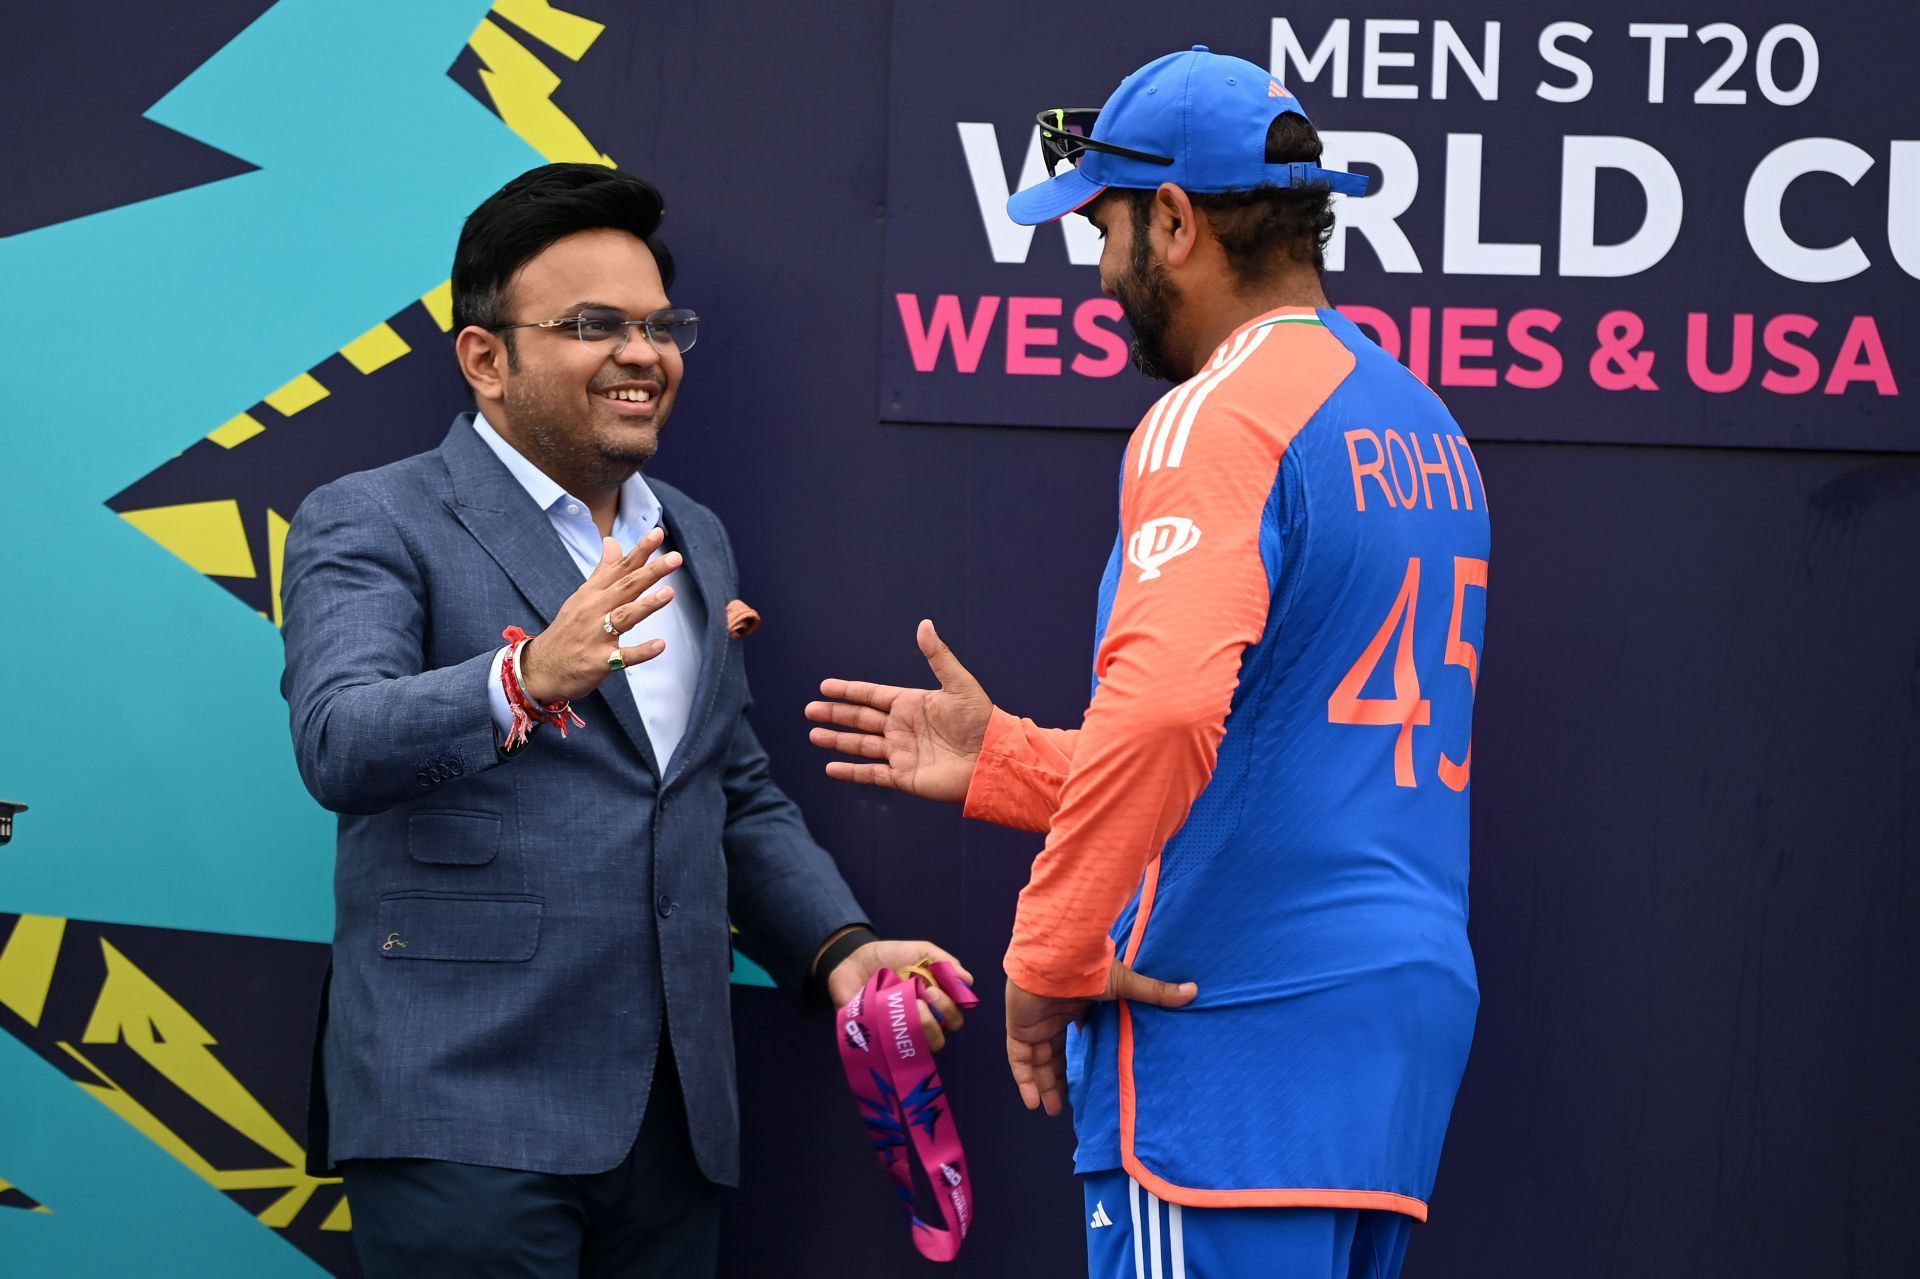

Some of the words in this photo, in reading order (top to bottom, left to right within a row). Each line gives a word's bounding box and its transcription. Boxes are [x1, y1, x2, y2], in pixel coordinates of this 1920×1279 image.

[1629, 23, 1820, 106] T20
[956, 123, 1684, 278] WRLD
[896, 293, 1129, 378] WES
[1589, 310, 1660, 391] &
[1687, 313, 1900, 396] USA
[1328, 557, 1489, 792] 45
[888, 991, 916, 1060] WINNER
